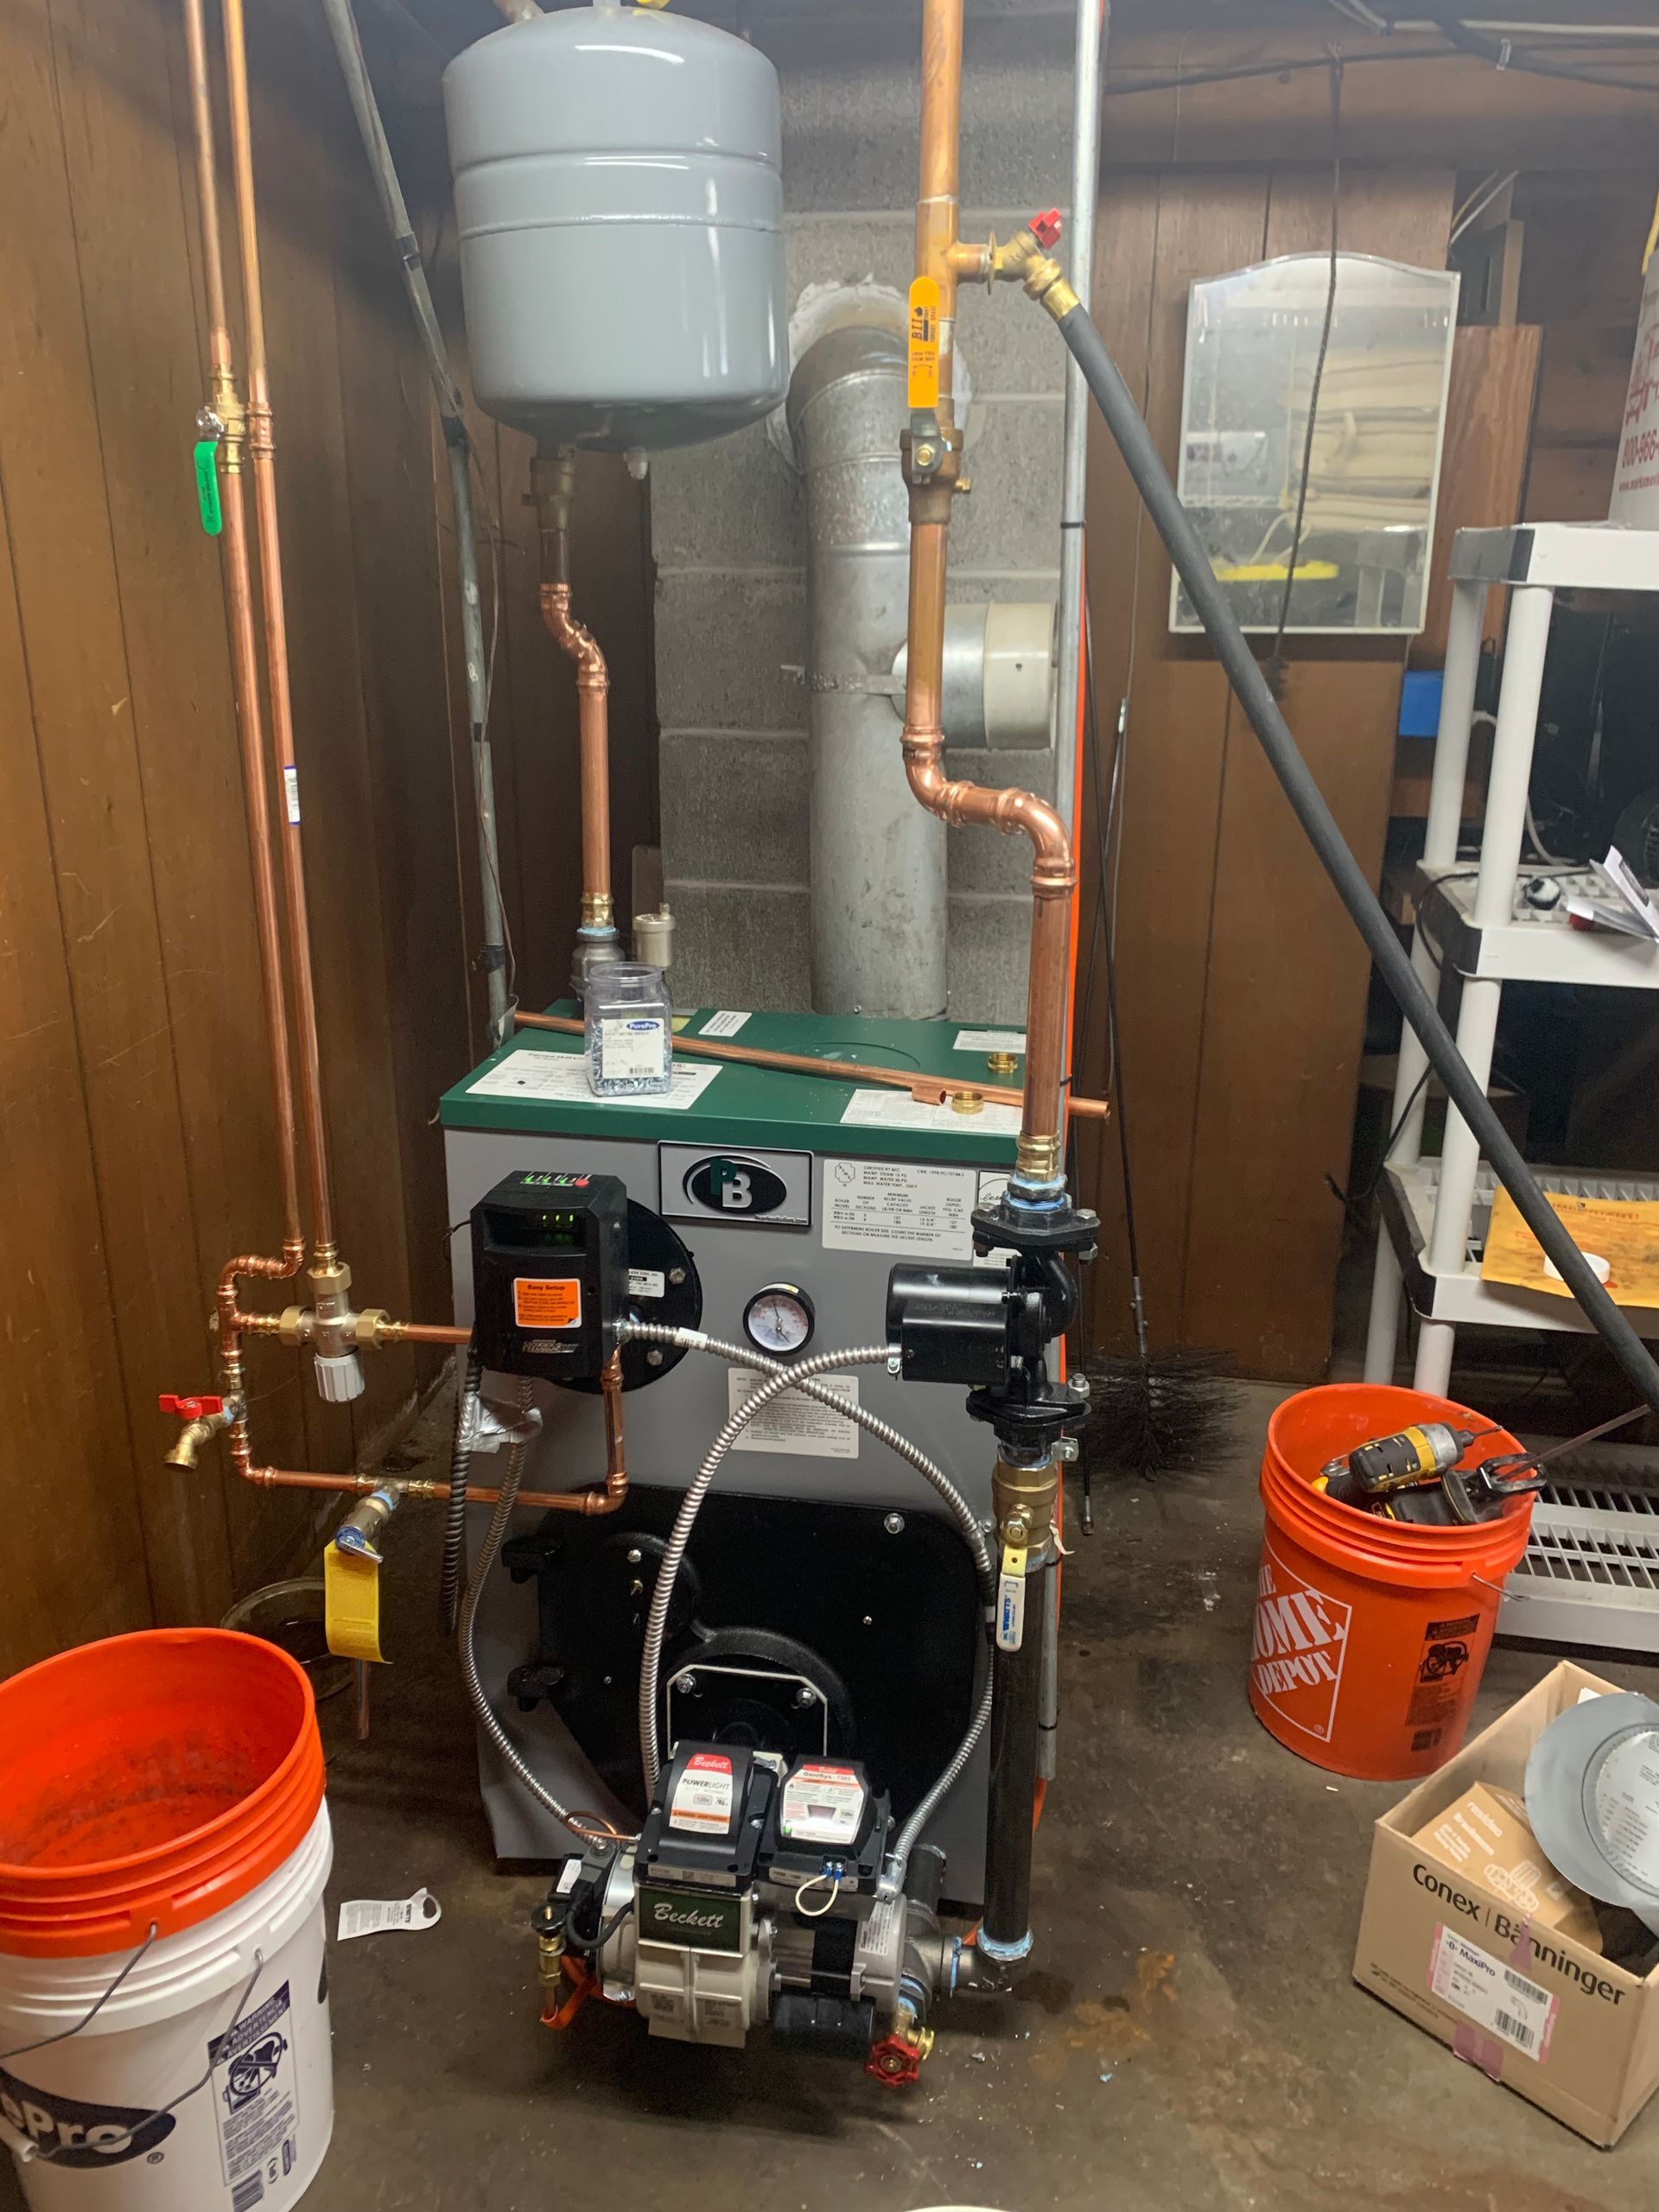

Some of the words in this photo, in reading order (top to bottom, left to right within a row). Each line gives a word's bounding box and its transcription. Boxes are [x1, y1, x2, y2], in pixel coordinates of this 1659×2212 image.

[912, 318, 923, 340] BII
[1621, 429, 1659, 468] 800-966-
[709, 1160, 753, 1208] PB
[1259, 1564, 1277, 1598] HE
[1002, 1597, 1011, 1631] WATTS
[1253, 1588, 1345, 1661] OME
[1257, 1650, 1338, 1695] DEPOT
[694, 1756, 729, 1770] Beckett
[803, 1770, 832, 1780] GeniSys
[682, 1777, 730, 1789] POWERLIGHT
[1413, 1864, 1479, 1922] Conex
[653, 1903, 724, 1929] Beckett
[1459, 1948, 1496, 1976] MaxiPro
[226, 2003, 288, 2057] AVERTISSEMENT
[231, 1999, 284, 2045] ADVERTENCIA
[238, 1996, 276, 2030] WARNING
[0, 2092, 131, 2154] ePro
